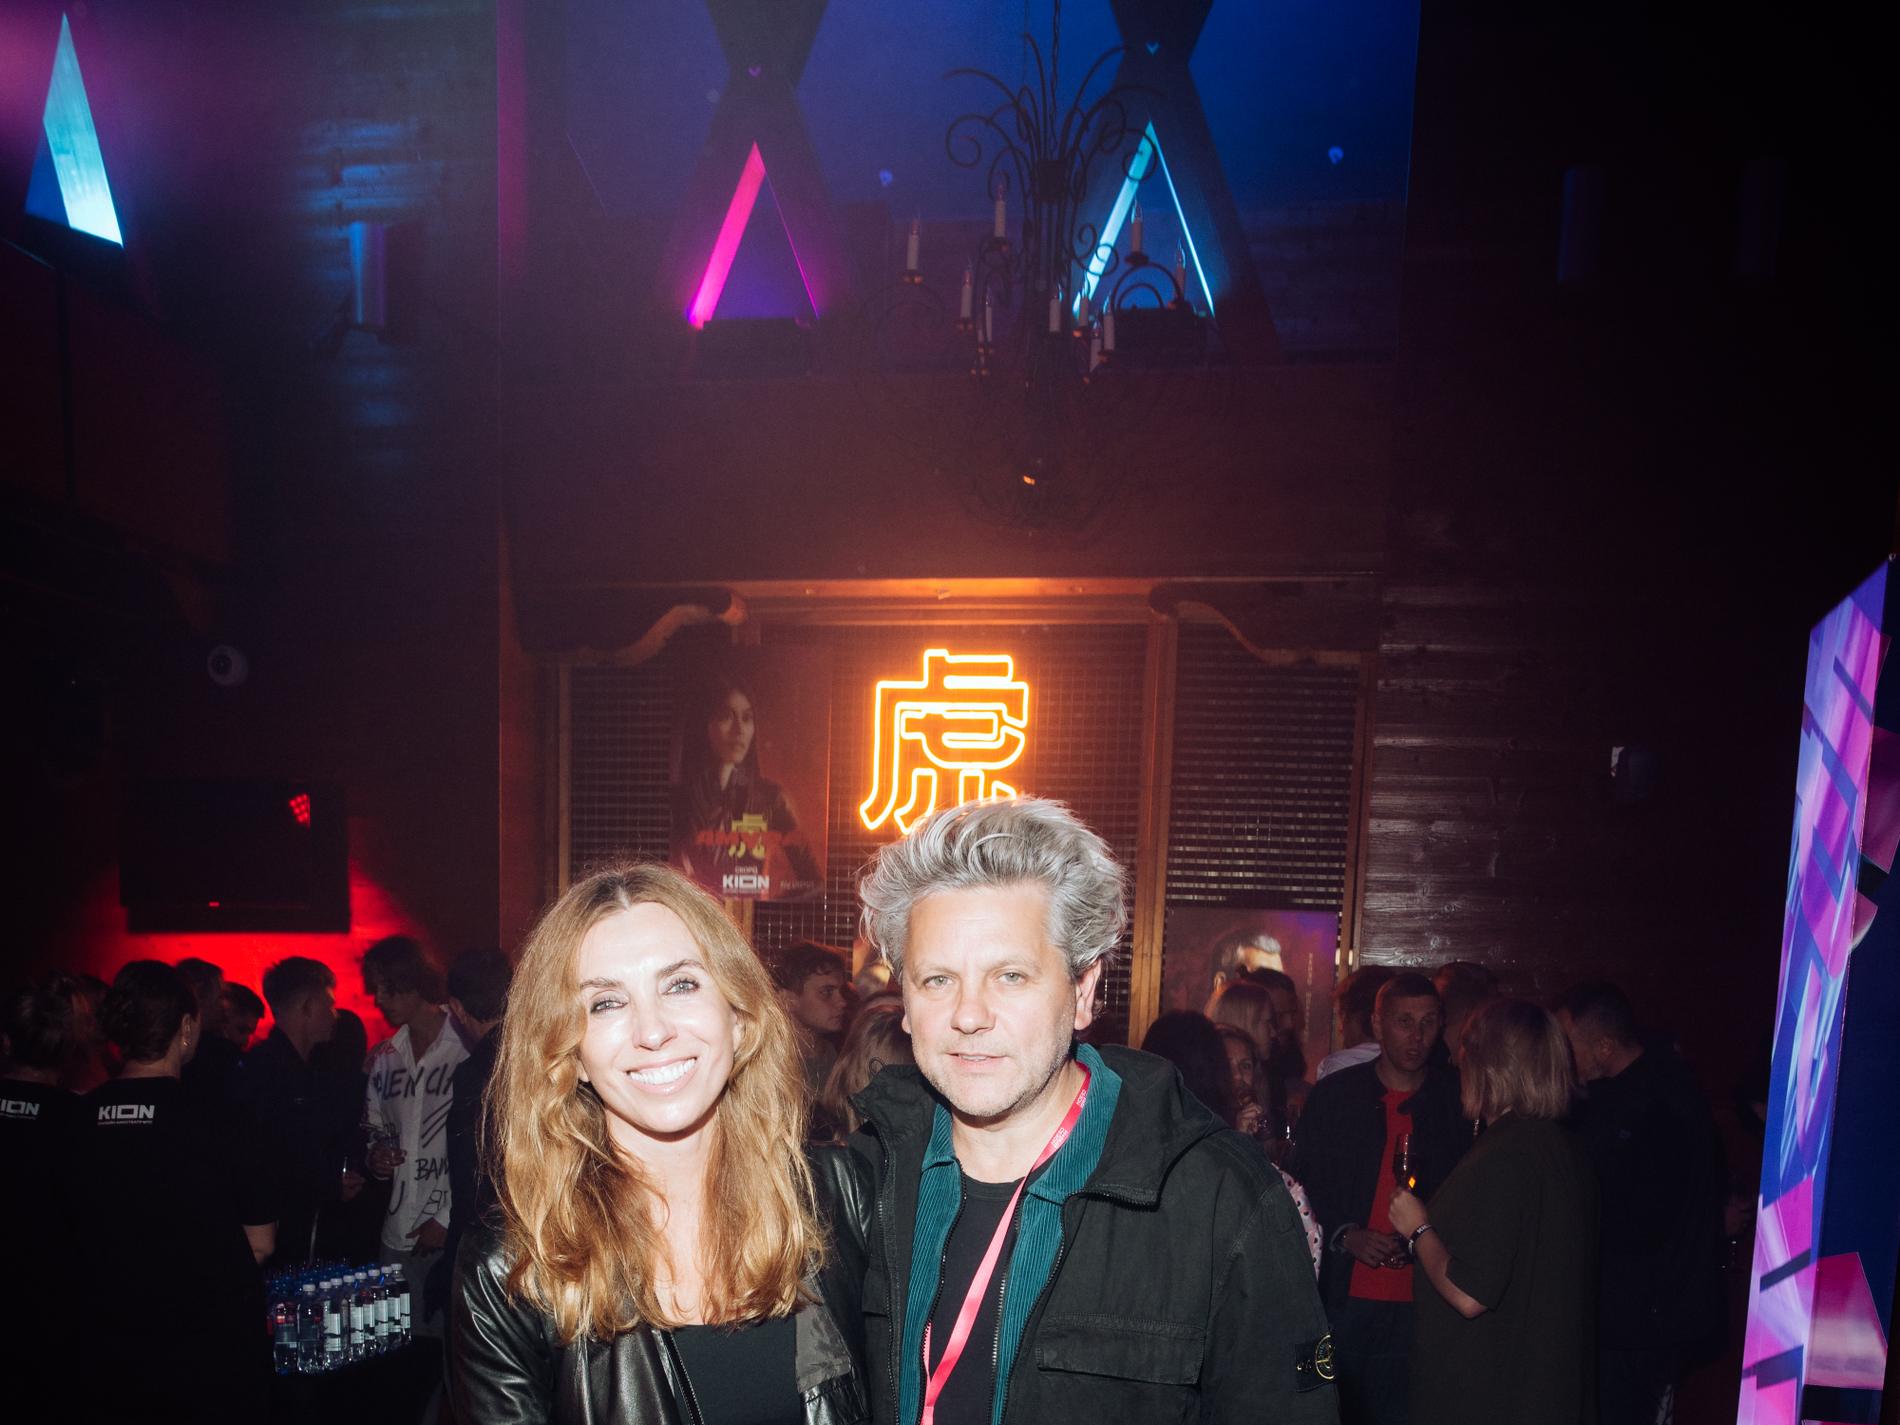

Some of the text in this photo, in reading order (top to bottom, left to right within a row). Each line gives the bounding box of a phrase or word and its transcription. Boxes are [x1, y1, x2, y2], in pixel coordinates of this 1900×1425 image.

[722, 874, 770, 889] KION
[0, 1098, 40, 1116] ION
[98, 1105, 155, 1120] KION
